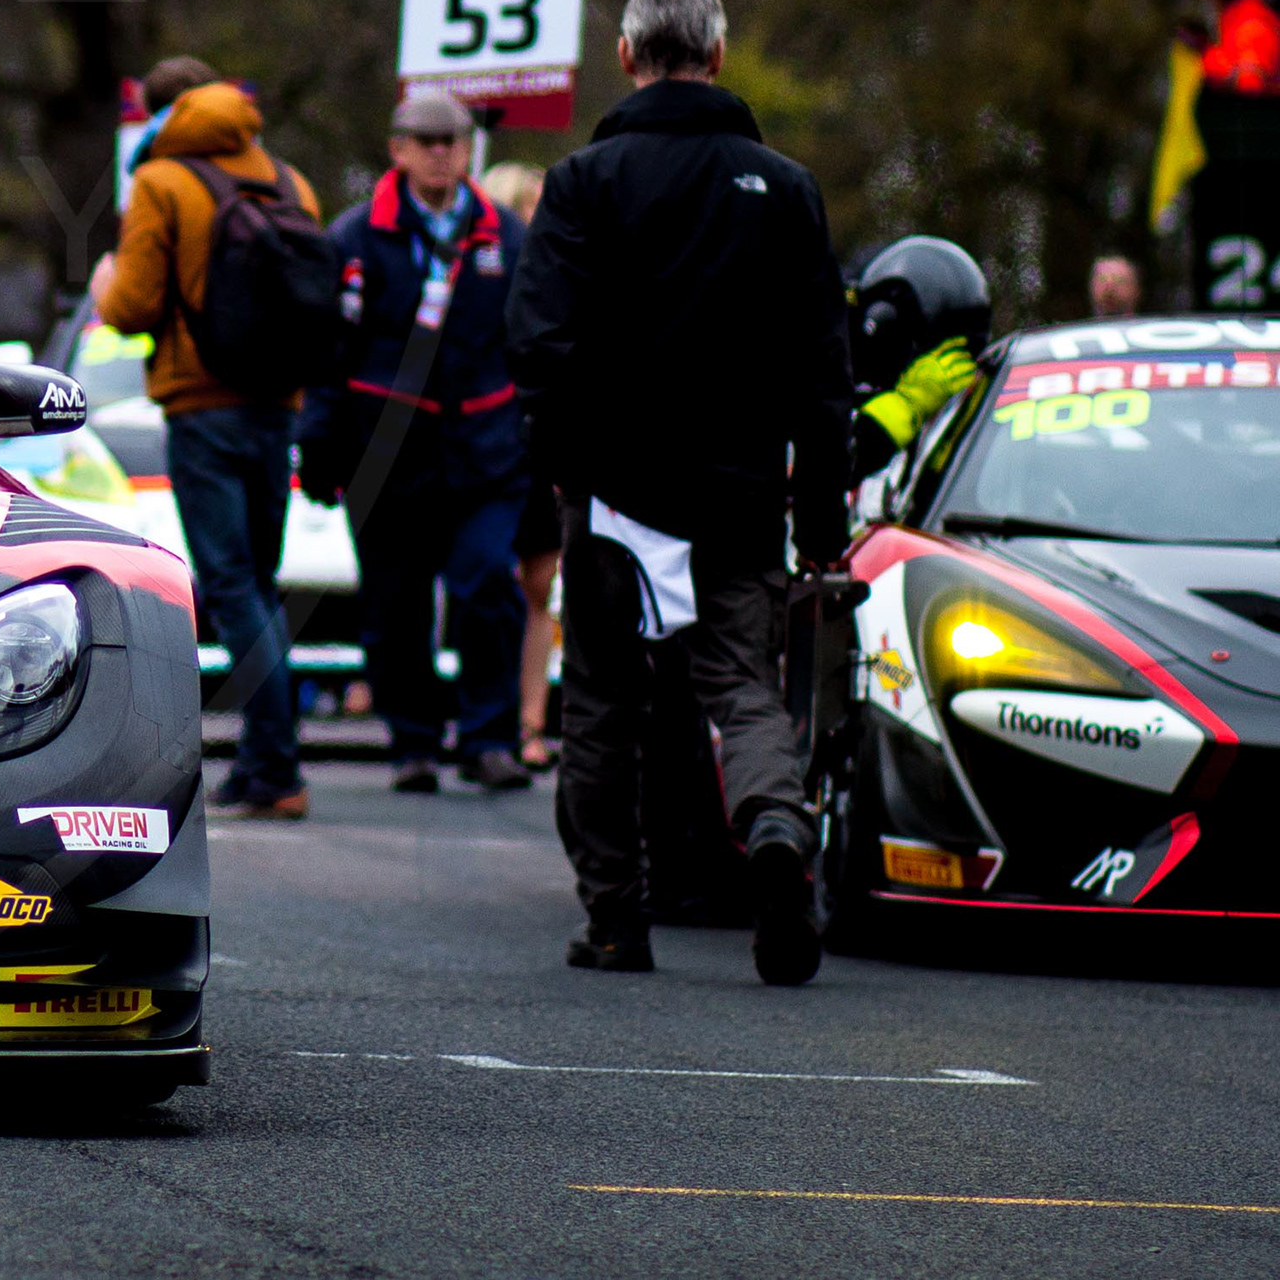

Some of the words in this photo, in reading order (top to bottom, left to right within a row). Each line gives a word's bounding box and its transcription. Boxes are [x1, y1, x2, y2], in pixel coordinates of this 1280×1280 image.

[1207, 236, 1280, 307] 2
[1028, 361, 1280, 399] BRITIS
[993, 389, 1151, 440] 100
[997, 701, 1141, 750] Thorntons
[52, 811, 148, 846] DRIVEN
[102, 840, 132, 848] RACING
[135, 841, 147, 849] OIL
